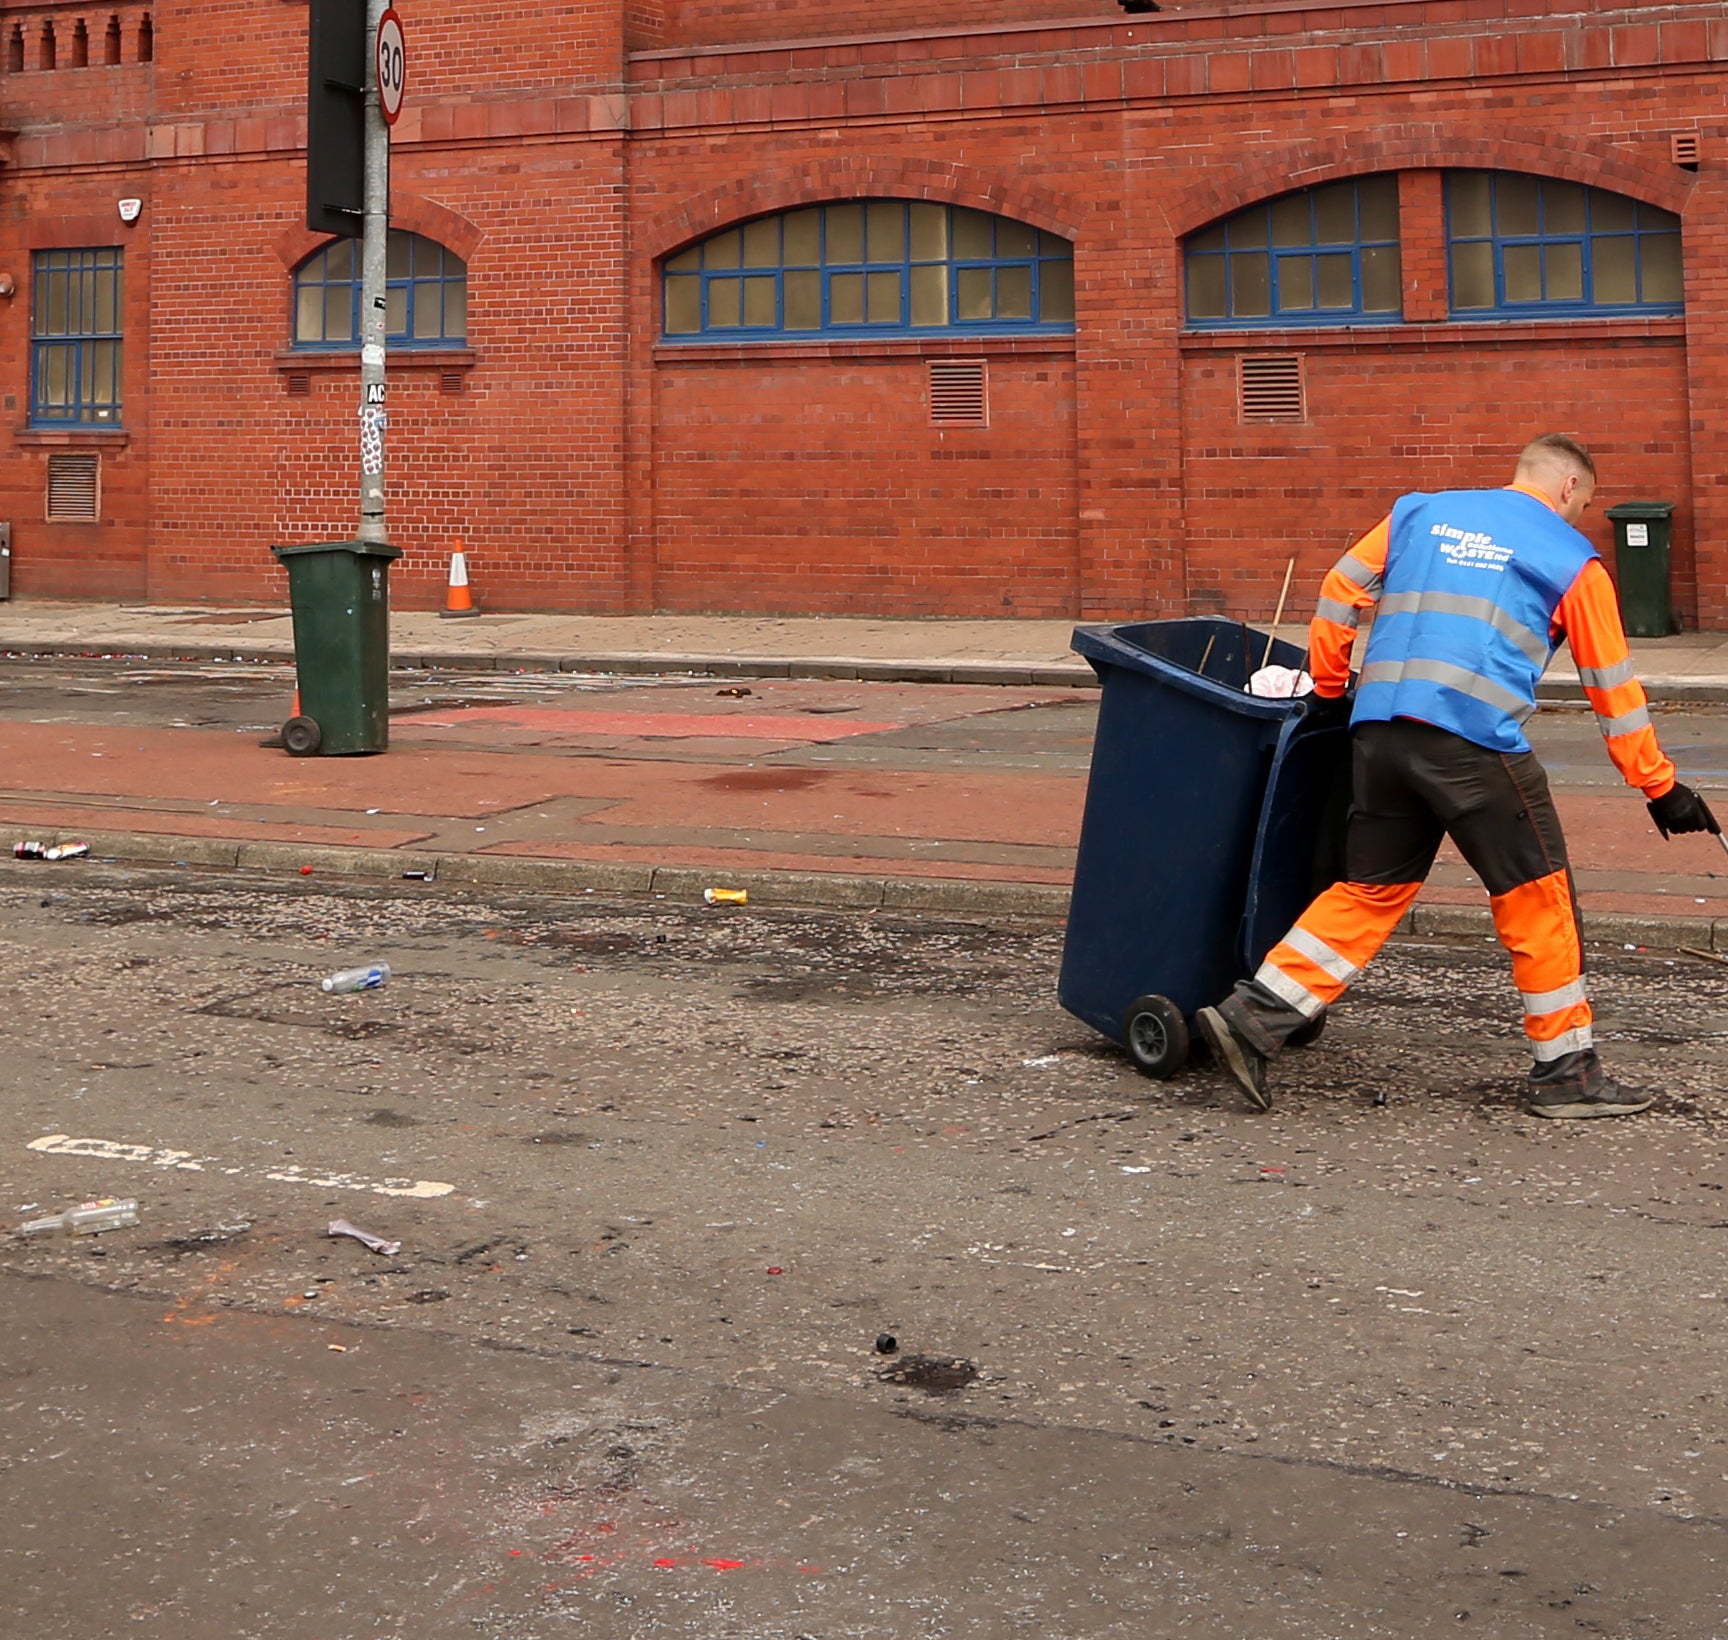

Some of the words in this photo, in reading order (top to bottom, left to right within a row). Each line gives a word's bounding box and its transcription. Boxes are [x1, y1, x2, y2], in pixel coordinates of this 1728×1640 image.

[381, 41, 402, 92] 30
[1430, 523, 1492, 549] simple
[1467, 543, 1514, 554] solutions
